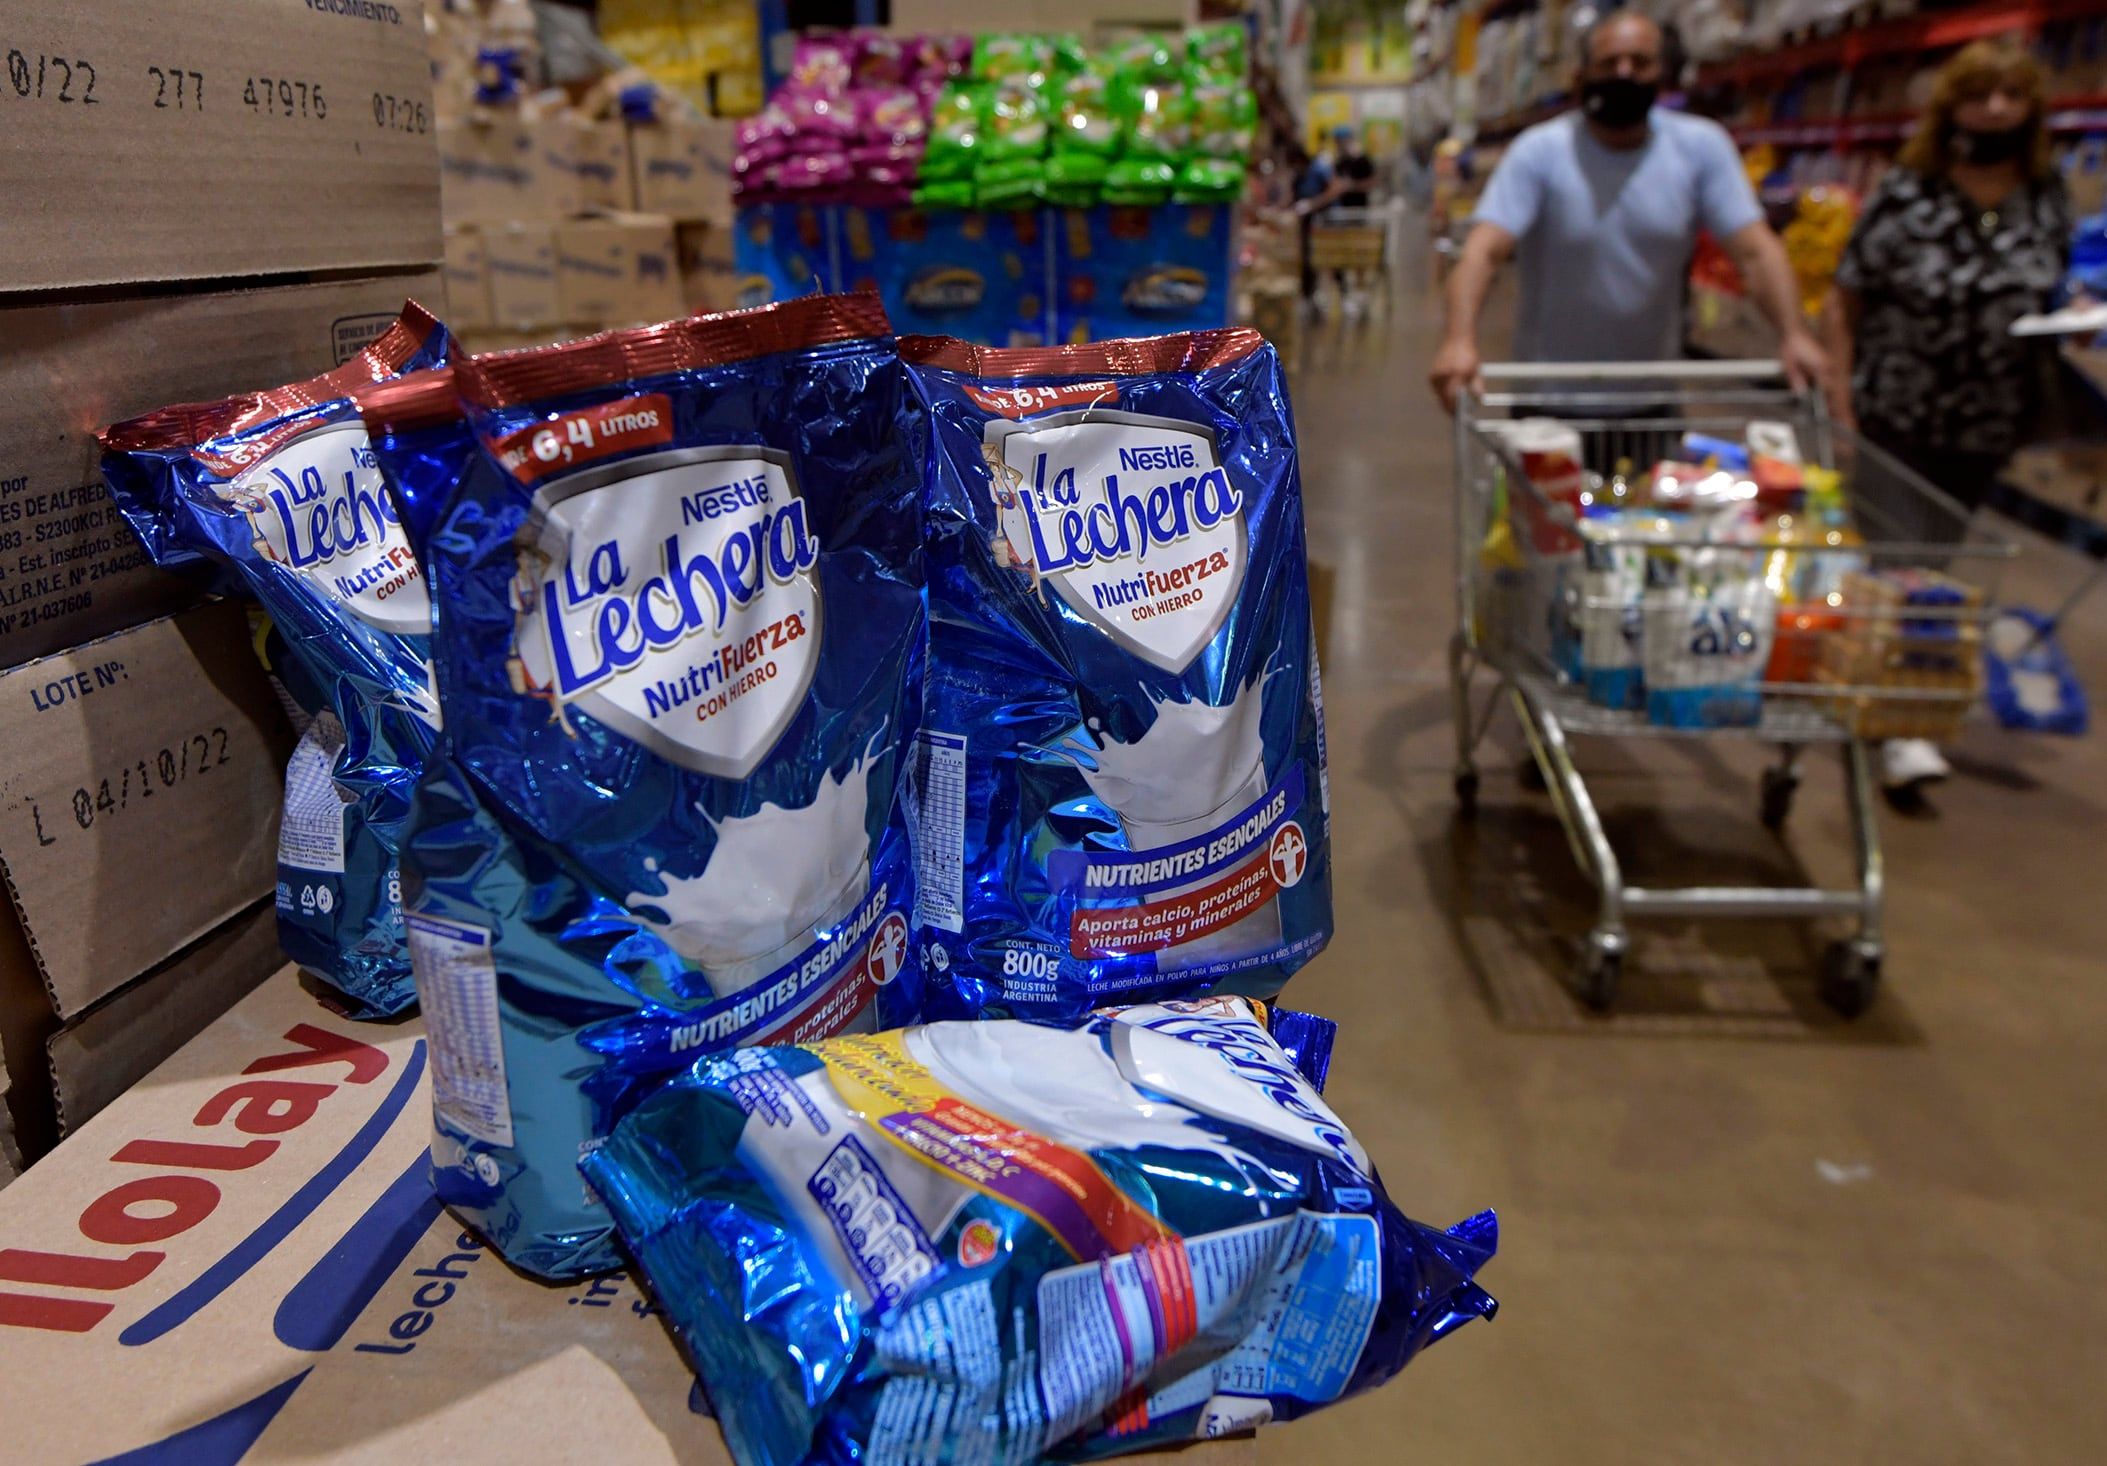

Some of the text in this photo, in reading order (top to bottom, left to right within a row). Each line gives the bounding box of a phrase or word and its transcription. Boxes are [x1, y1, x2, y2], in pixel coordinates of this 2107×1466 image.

[148, 66, 204, 112] 277
[243, 77, 327, 119] 47976
[532, 418, 595, 463] 6,4
[600, 410, 659, 437] LITROS
[1119, 444, 1198, 472] Nestlé
[25, 496, 47, 517] DE
[269, 464, 328, 505] La
[681, 474, 772, 526] Nestlé
[1033, 452, 1082, 509] La
[1020, 467, 1241, 573] Lechera
[19, 554, 48, 574] Est.
[50, 537, 111, 567] inscripto
[564, 536, 630, 608] La
[1092, 550, 1229, 609] NutriFuerza
[20, 591, 93, 629] 21-037606
[376, 573, 406, 601] CON
[543, 498, 818, 697] Lechera
[1131, 588, 1203, 622] CON HIERRO
[30, 670, 94, 712] LOTE
[642, 611, 806, 719] NutriFuerza
[696, 661, 777, 722] CON HIERRO
[72, 727, 232, 830] 04/10/22
[1085, 789, 1287, 889] NUTRIENTES ESENCIALES
[1078, 868, 1269, 938] Aporta calcio, proteínas,
[1088, 887, 1263, 951] vitaminas y minerales
[669, 882, 889, 1053] NUTRIENTES ESENCIALES
[1002, 949, 1060, 981] 800g
[1035, 941, 1061, 954] NETO
[1087, 981, 1108, 992] LECHE
[1111, 975, 1153, 990] MODIFICADA
[1155, 973, 1165, 983] EN
[1167, 968, 1188, 981] POLVO
[1190, 966, 1207, 977] PARA
[1210, 963, 1229, 974] NIÑOS
[1238, 956, 1259, 968] PARTIR
[1261, 954, 1269, 964] DE
[1002, 990, 1058, 1003] ARGENTINA
[1003, 980, 1057, 993] INDUSTRIA
